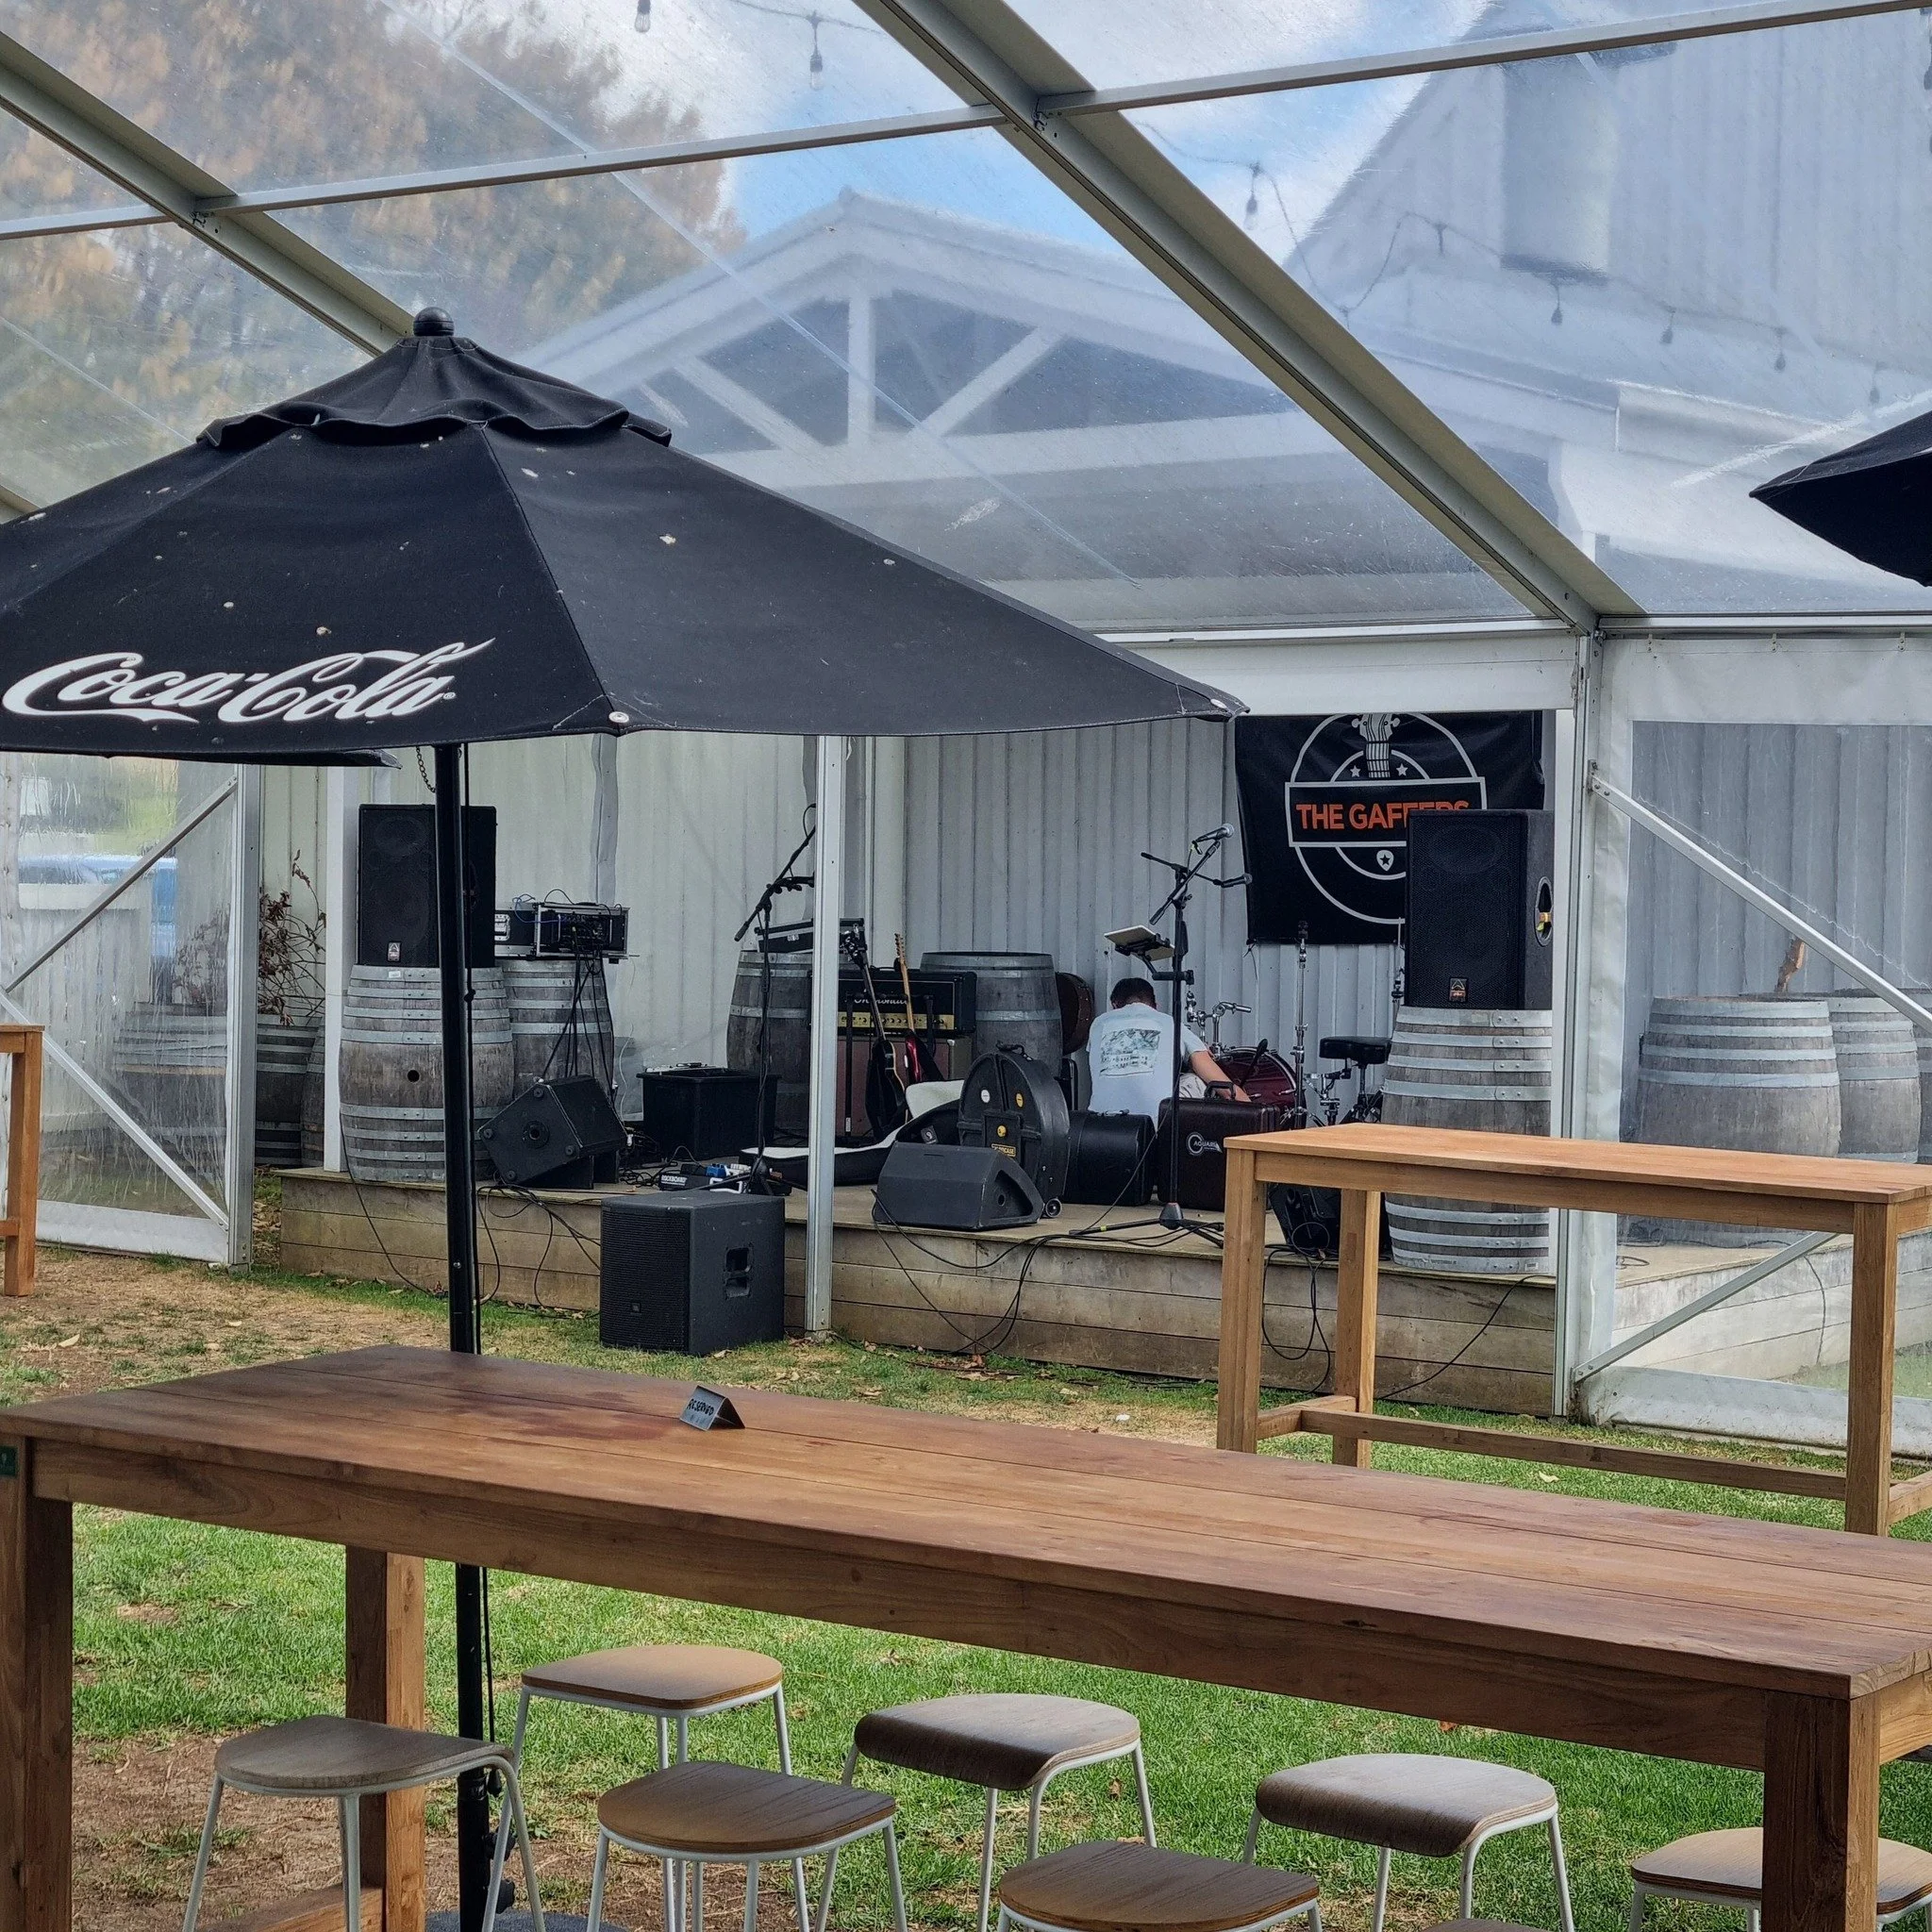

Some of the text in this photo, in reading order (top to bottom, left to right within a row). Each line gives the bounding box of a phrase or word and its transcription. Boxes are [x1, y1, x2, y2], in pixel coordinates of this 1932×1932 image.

[2, 637, 496, 723] Coca-Cola
[1295, 800, 1470, 829] THE GAFF
[686, 1398, 715, 1416] RESERVED
